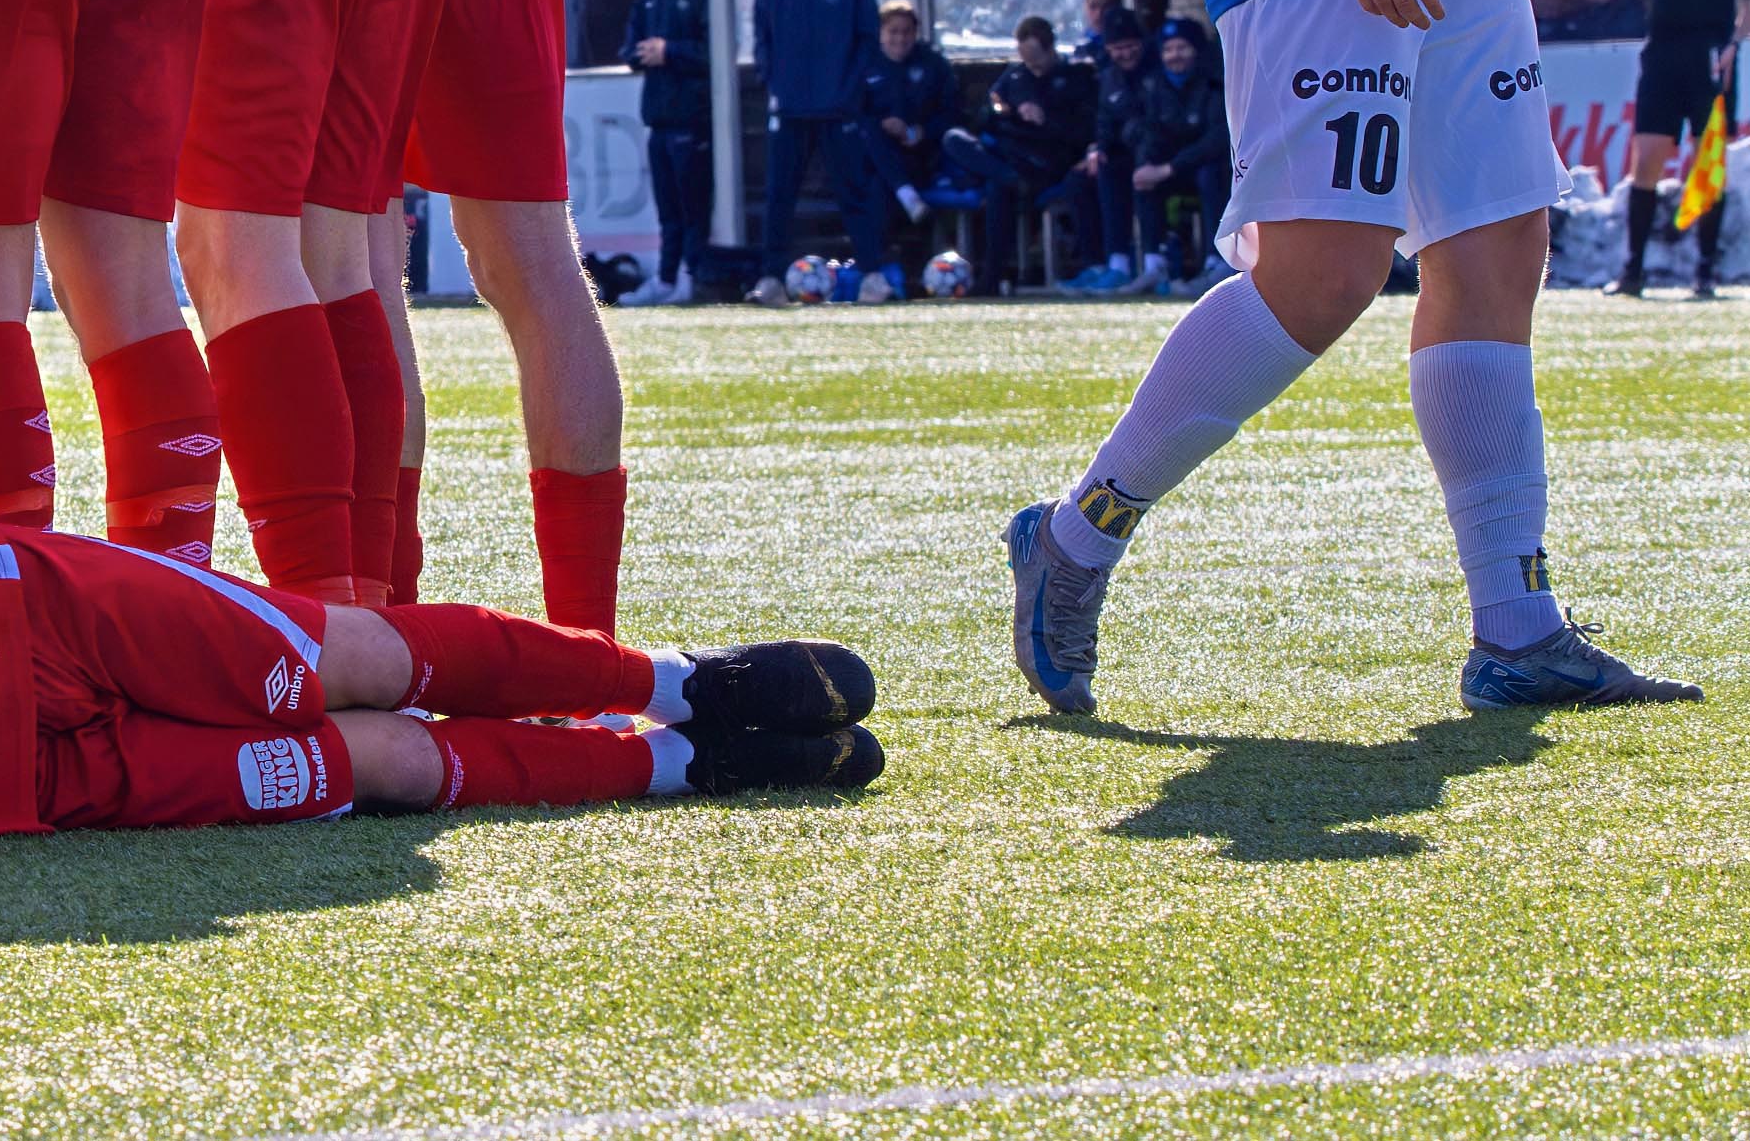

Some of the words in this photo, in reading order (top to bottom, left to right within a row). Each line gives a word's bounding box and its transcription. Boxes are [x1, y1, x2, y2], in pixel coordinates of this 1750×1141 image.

[1326, 111, 1400, 195] 10
[287, 665, 306, 710] umbro
[252, 740, 277, 809] BURGER
[267, 738, 298, 808] KING
[307, 736, 328, 801] Triaden
